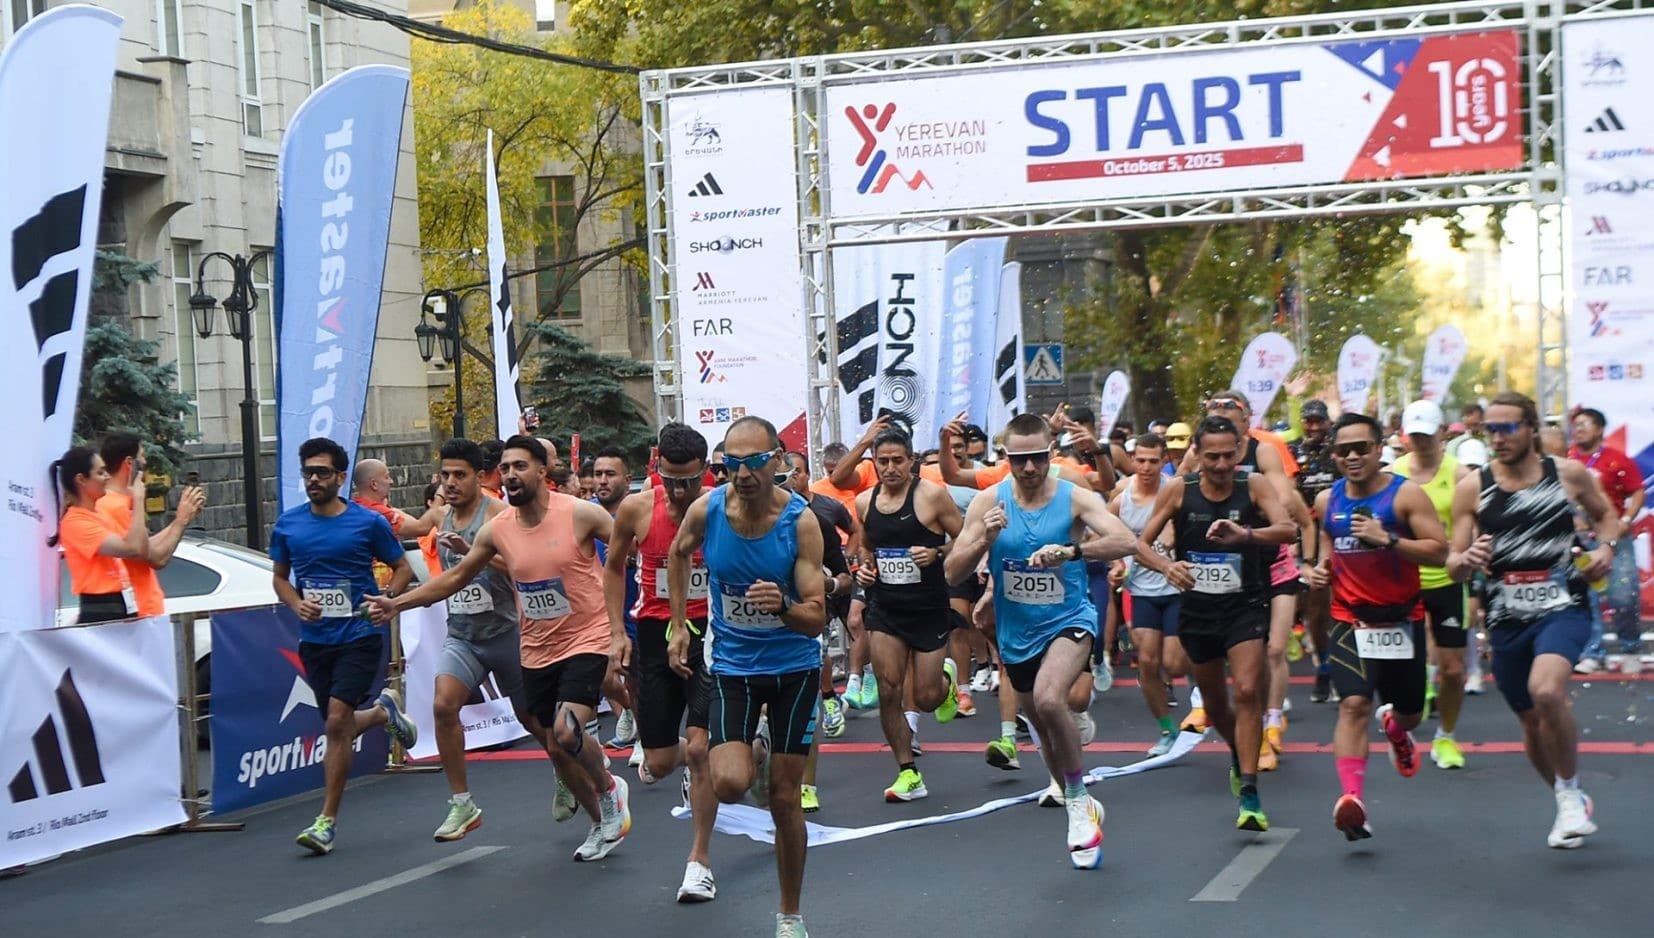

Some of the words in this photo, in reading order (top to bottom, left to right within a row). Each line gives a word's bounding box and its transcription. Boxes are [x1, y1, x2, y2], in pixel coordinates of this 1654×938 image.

[1428, 58, 1508, 149] 10
[1472, 75, 1492, 128] years
[1024, 70, 1301, 157] START
[895, 120, 986, 143] YEREVAN
[896, 140, 986, 161] MARATHON
[1103, 156, 1165, 177] October
[1167, 156, 1182, 173] 5,
[1184, 152, 1224, 170] 2025
[1584, 265, 1633, 287] FAR
[693, 318, 734, 337] FAR
[1248, 380, 1273, 392] 1:39
[881, 561, 914, 574] 2095
[1195, 567, 1231, 582] 2192
[1013, 576, 1055, 592] 2051
[1513, 584, 1560, 602] 4090
[526, 593, 556, 609] 2118
[1366, 631, 1404, 647] 4100
